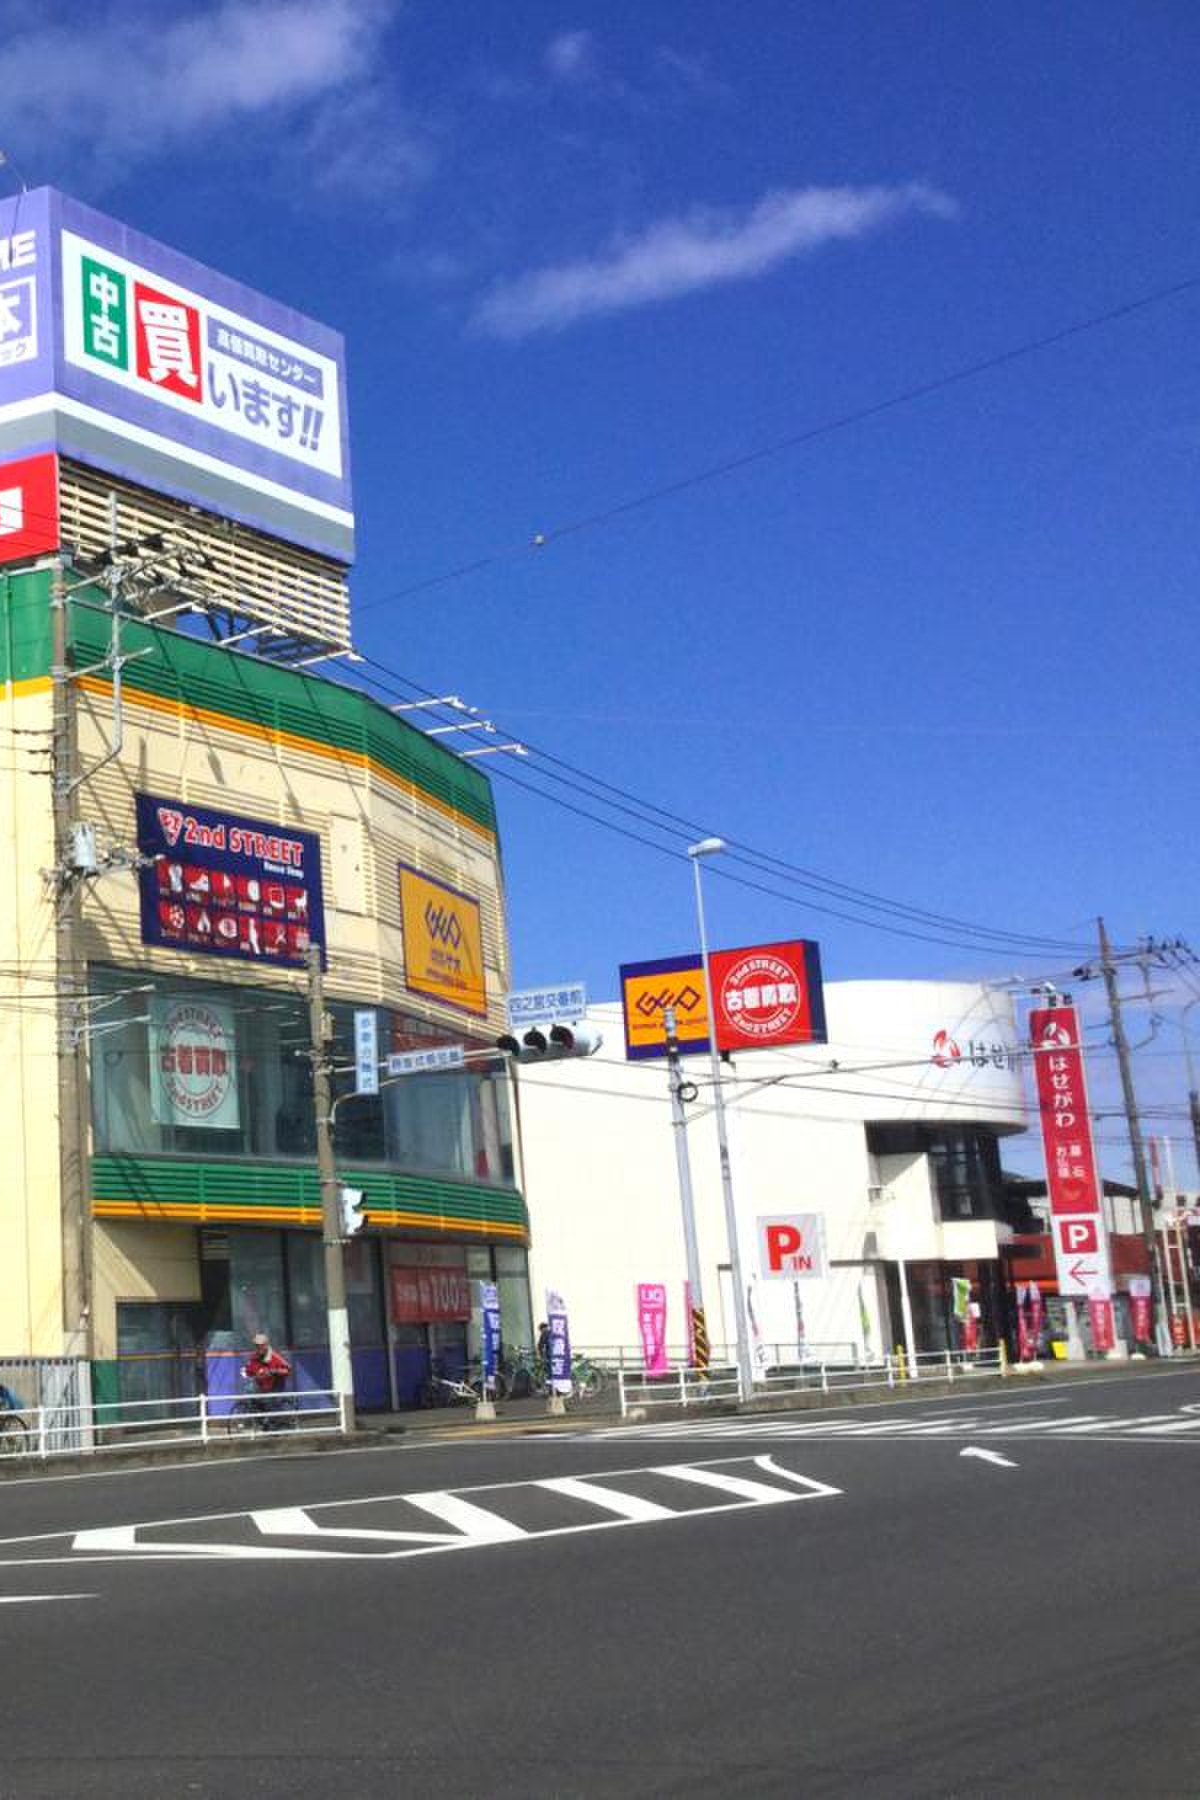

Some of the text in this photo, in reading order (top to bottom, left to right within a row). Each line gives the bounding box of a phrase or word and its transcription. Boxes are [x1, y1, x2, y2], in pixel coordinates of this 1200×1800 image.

[89, 272, 120, 359] 中古
[138, 299, 199, 388] 買
[184, 815, 305, 866] 2nd STREET
[636, 985, 701, 1016] GEO
[1049, 1056, 1075, 1128] はせがわ
[767, 1225, 801, 1271] P
[1068, 1225, 1089, 1249] P
[793, 1255, 812, 1271] IN
